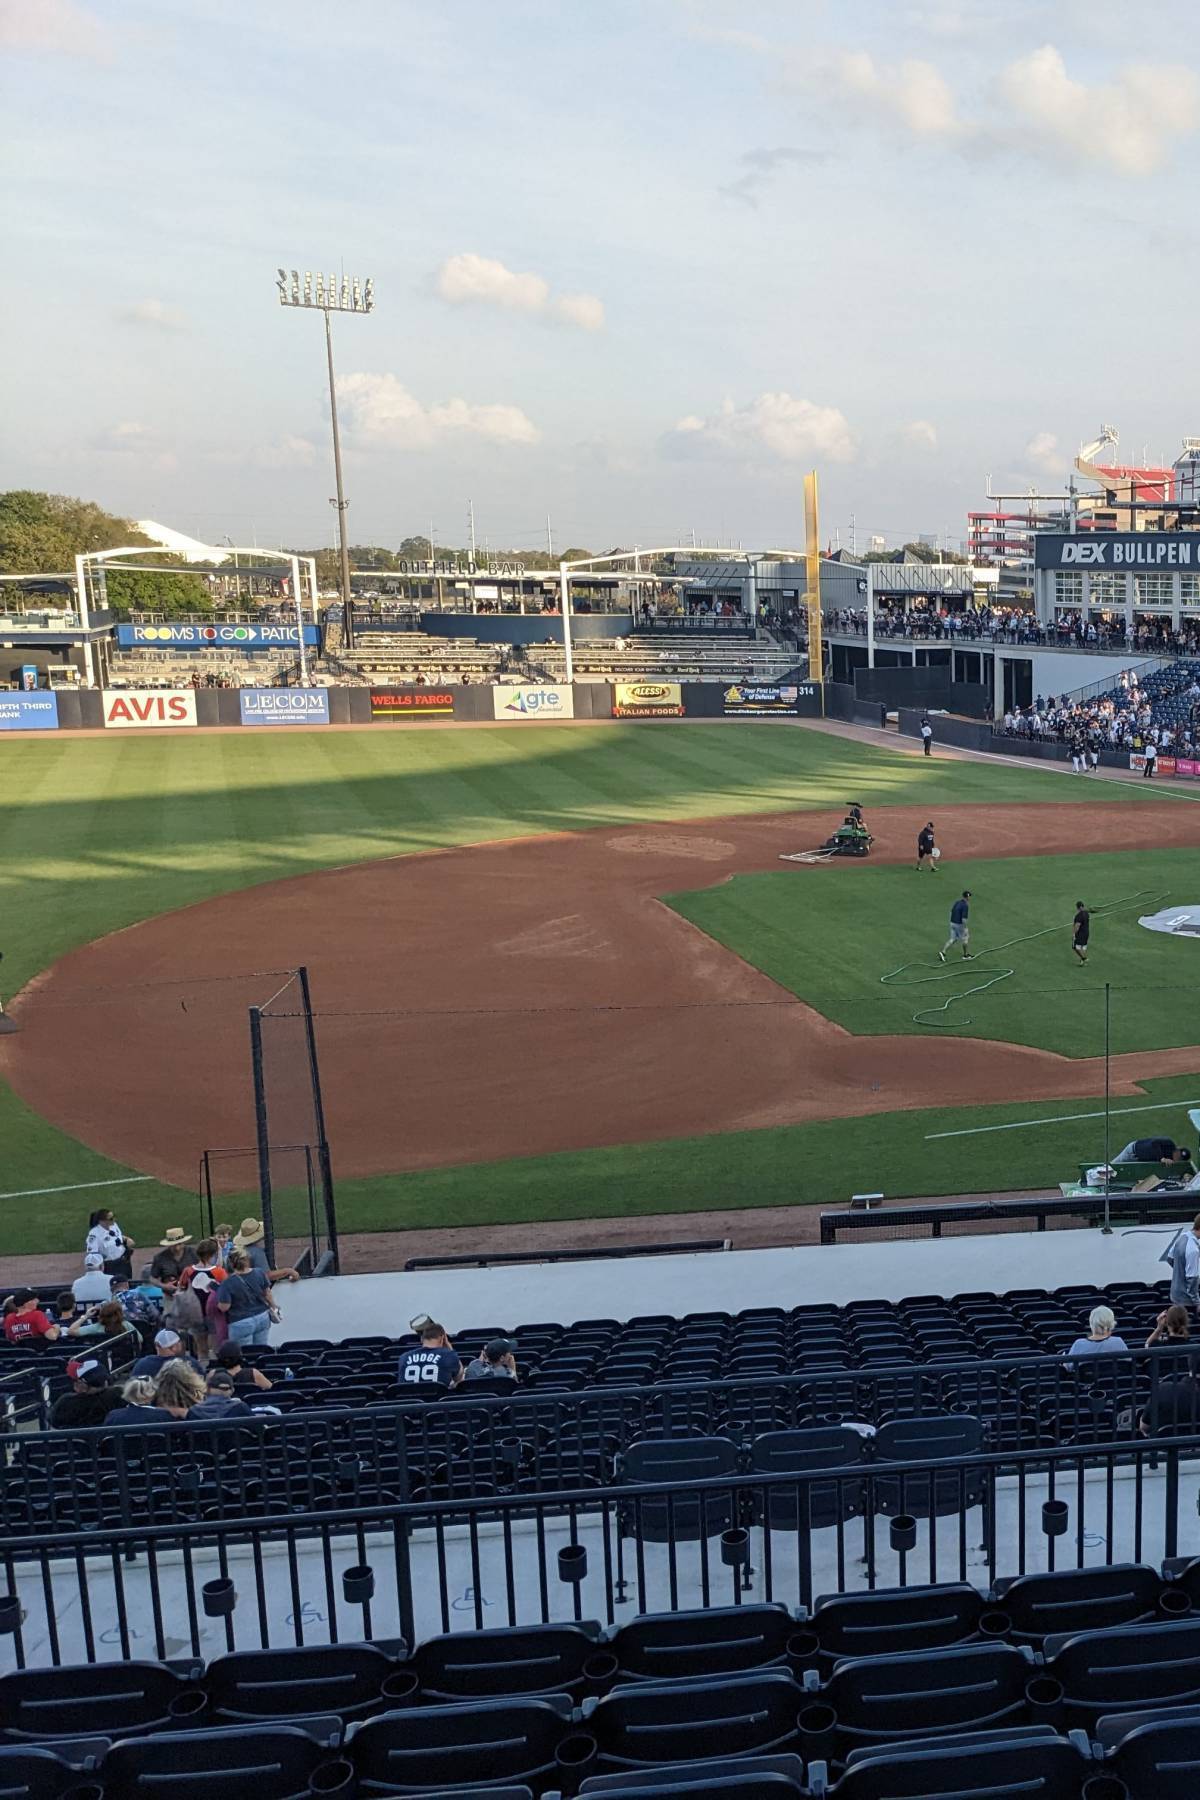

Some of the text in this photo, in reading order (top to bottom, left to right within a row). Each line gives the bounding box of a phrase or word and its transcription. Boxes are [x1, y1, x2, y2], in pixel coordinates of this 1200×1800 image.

[1061, 542, 1109, 563] DEX
[1113, 543, 1191, 564] BULLPEN
[400, 560, 525, 576] OUTFIELD BAR
[134, 628, 194, 640] ROOMS
[195, 627, 217, 640] TO
[220, 627, 248, 640] GO
[634, 687, 663, 696] ALESSI
[799, 686, 814, 695] 314
[243, 695, 325, 708] LECOM
[372, 695, 453, 705] WELLS FARGO
[526, 690, 559, 709] gte
[108, 696, 188, 721] AVIS
[406, 1352, 441, 1365] JUDGE
[404, 1364, 439, 1383] 99
